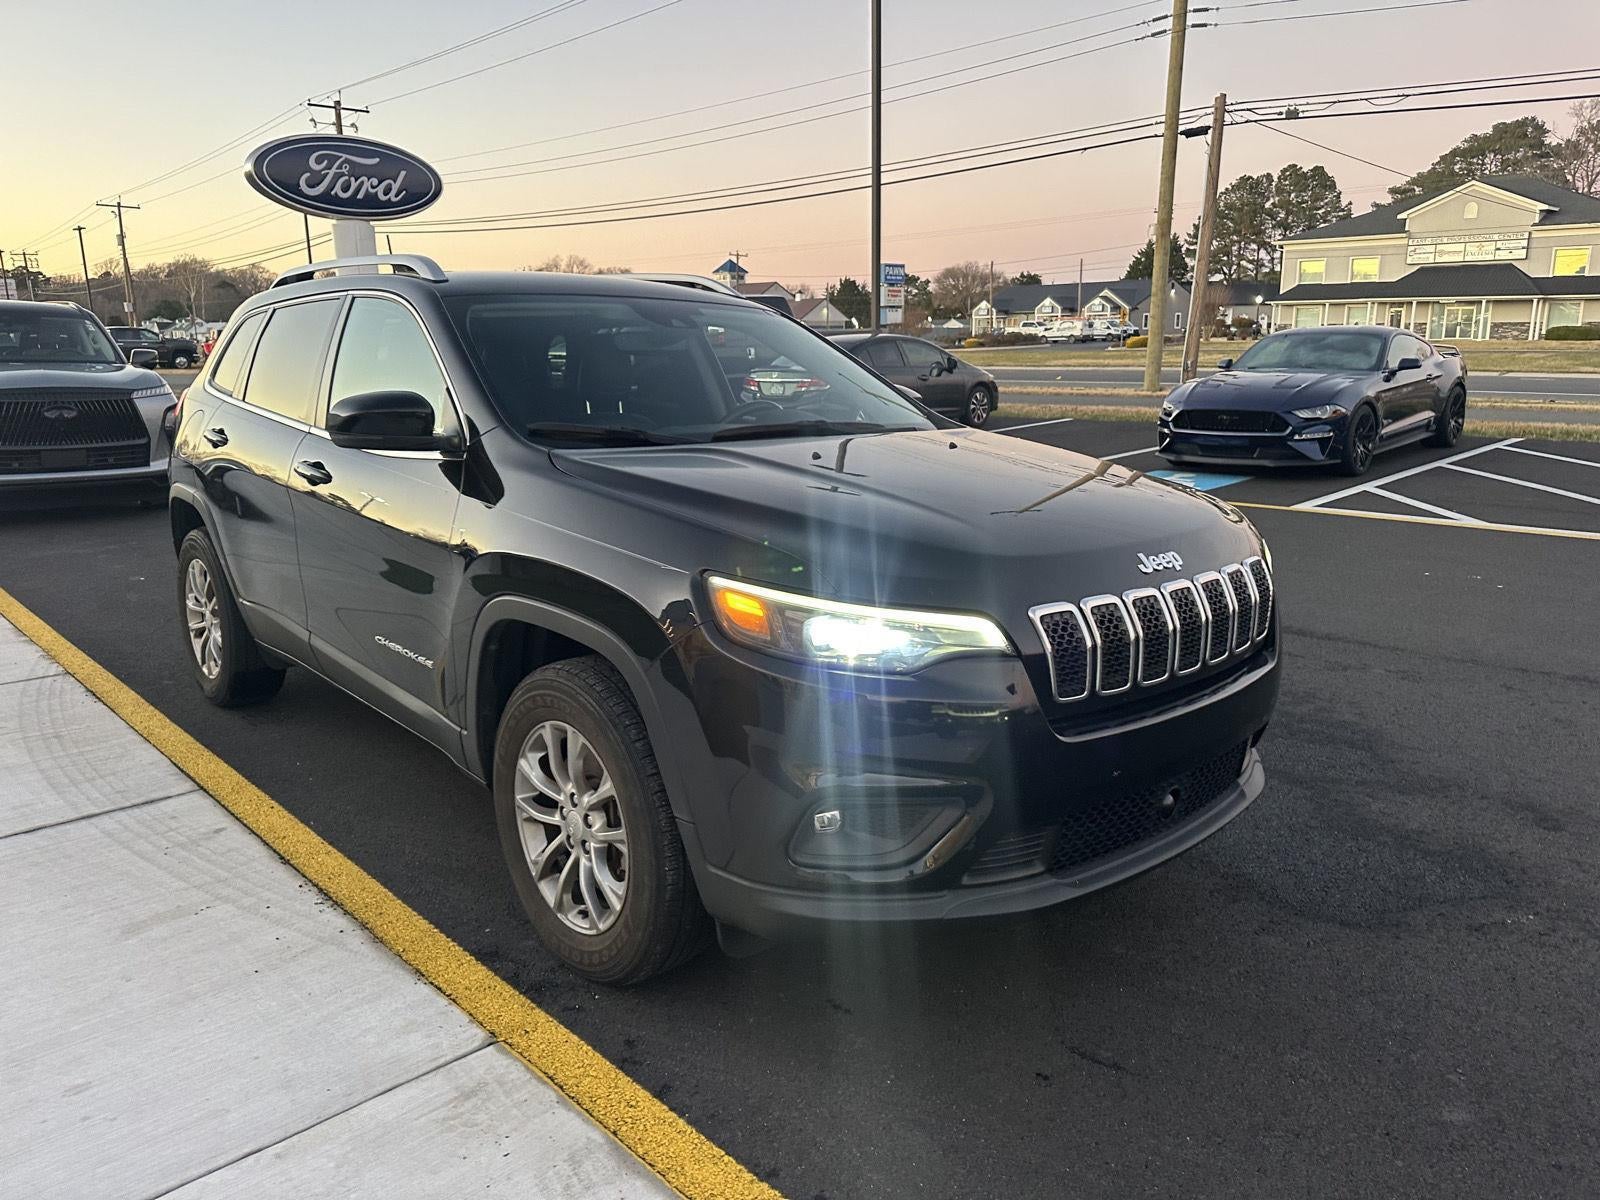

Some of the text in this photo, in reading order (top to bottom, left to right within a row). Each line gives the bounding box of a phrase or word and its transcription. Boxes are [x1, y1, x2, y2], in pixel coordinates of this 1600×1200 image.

[299, 150, 407, 202] Ford
[885, 266, 904, 276] PAWN
[1137, 550, 1183, 573] Jeep
